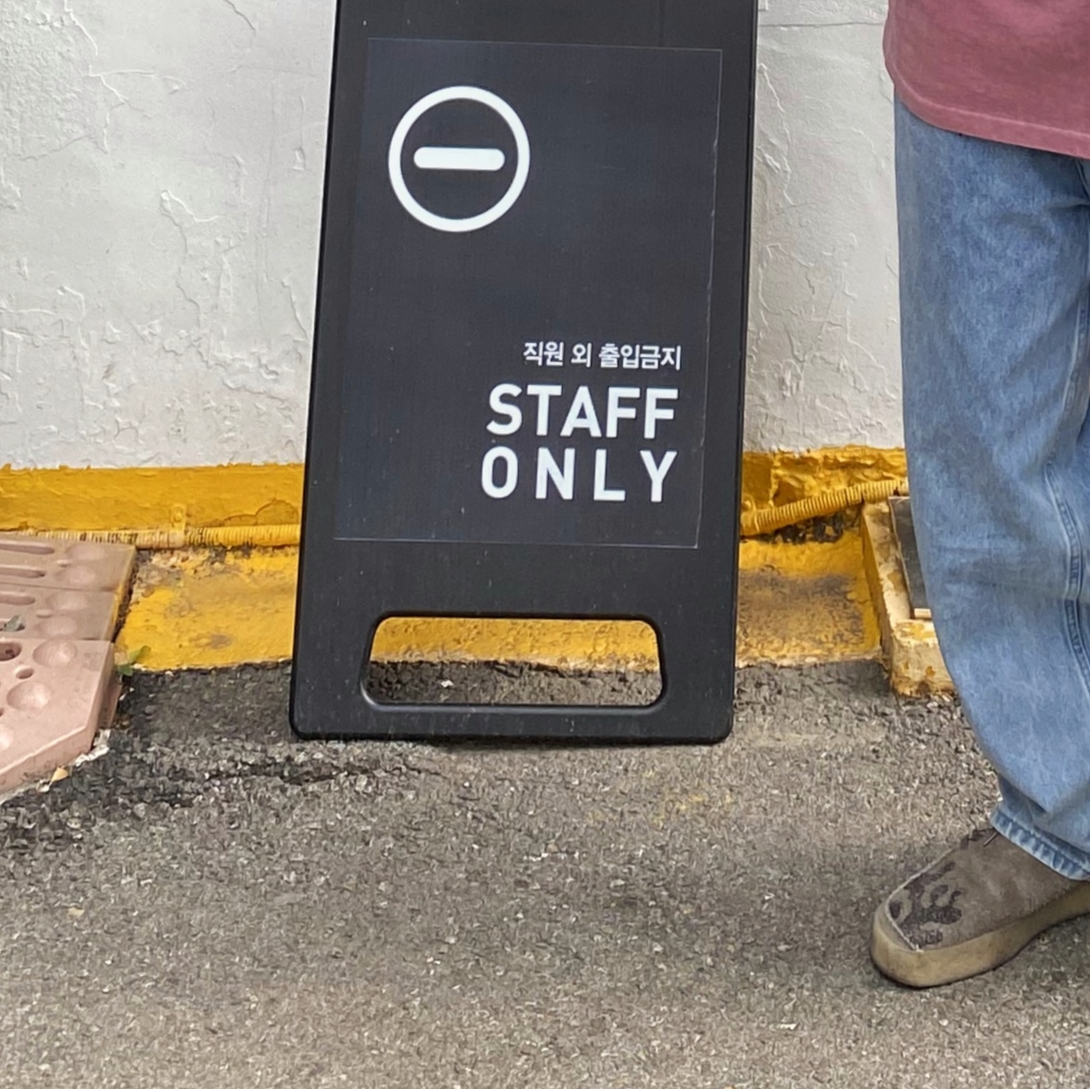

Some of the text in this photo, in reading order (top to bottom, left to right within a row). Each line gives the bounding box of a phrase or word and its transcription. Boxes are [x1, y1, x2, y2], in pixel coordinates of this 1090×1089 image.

[523, 341, 682, 371] 직원 외 출입금지
[486, 383, 679, 439] STAFF
[481, 446, 678, 503] ONLY
